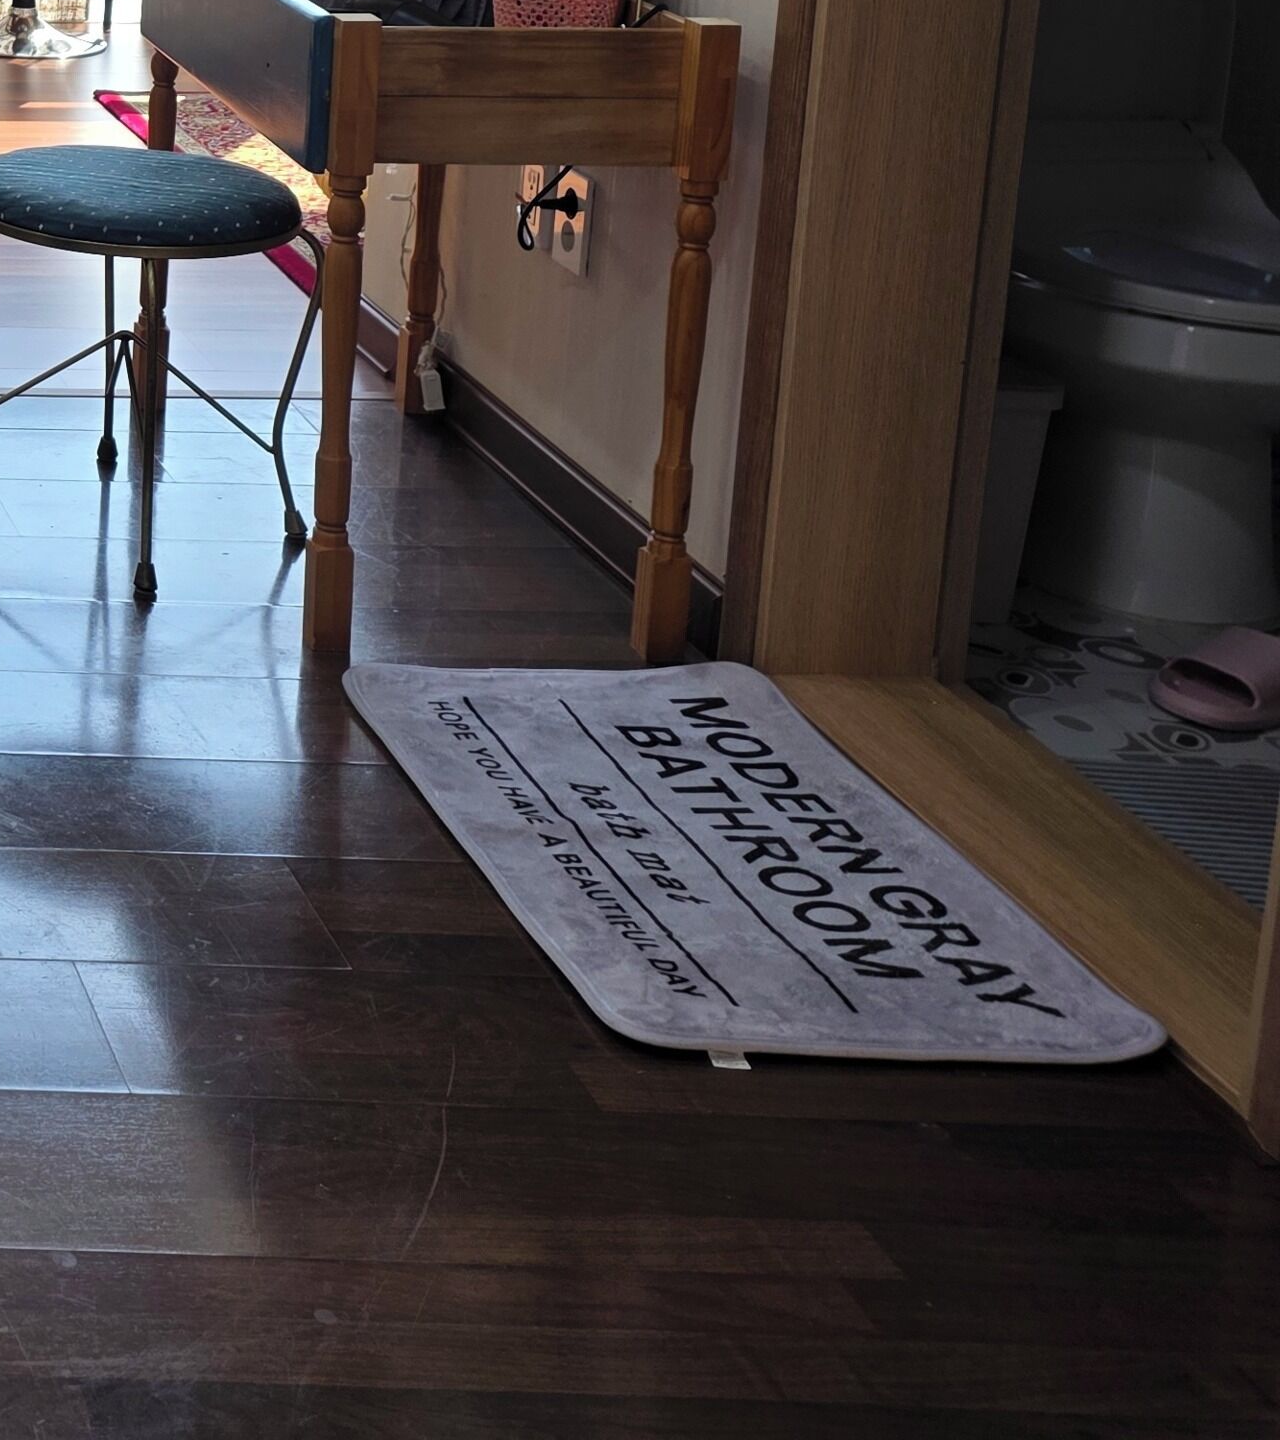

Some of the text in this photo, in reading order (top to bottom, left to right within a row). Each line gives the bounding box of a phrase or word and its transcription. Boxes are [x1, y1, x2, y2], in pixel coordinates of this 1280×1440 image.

[427, 700, 708, 999] HOPE YOU HAVE A BEAUTIFUL DAY
[568, 781, 711, 905] bath mat
[614, 724, 926, 980] BATHROOM
[669, 696, 1067, 1018] MODERN GRAY
